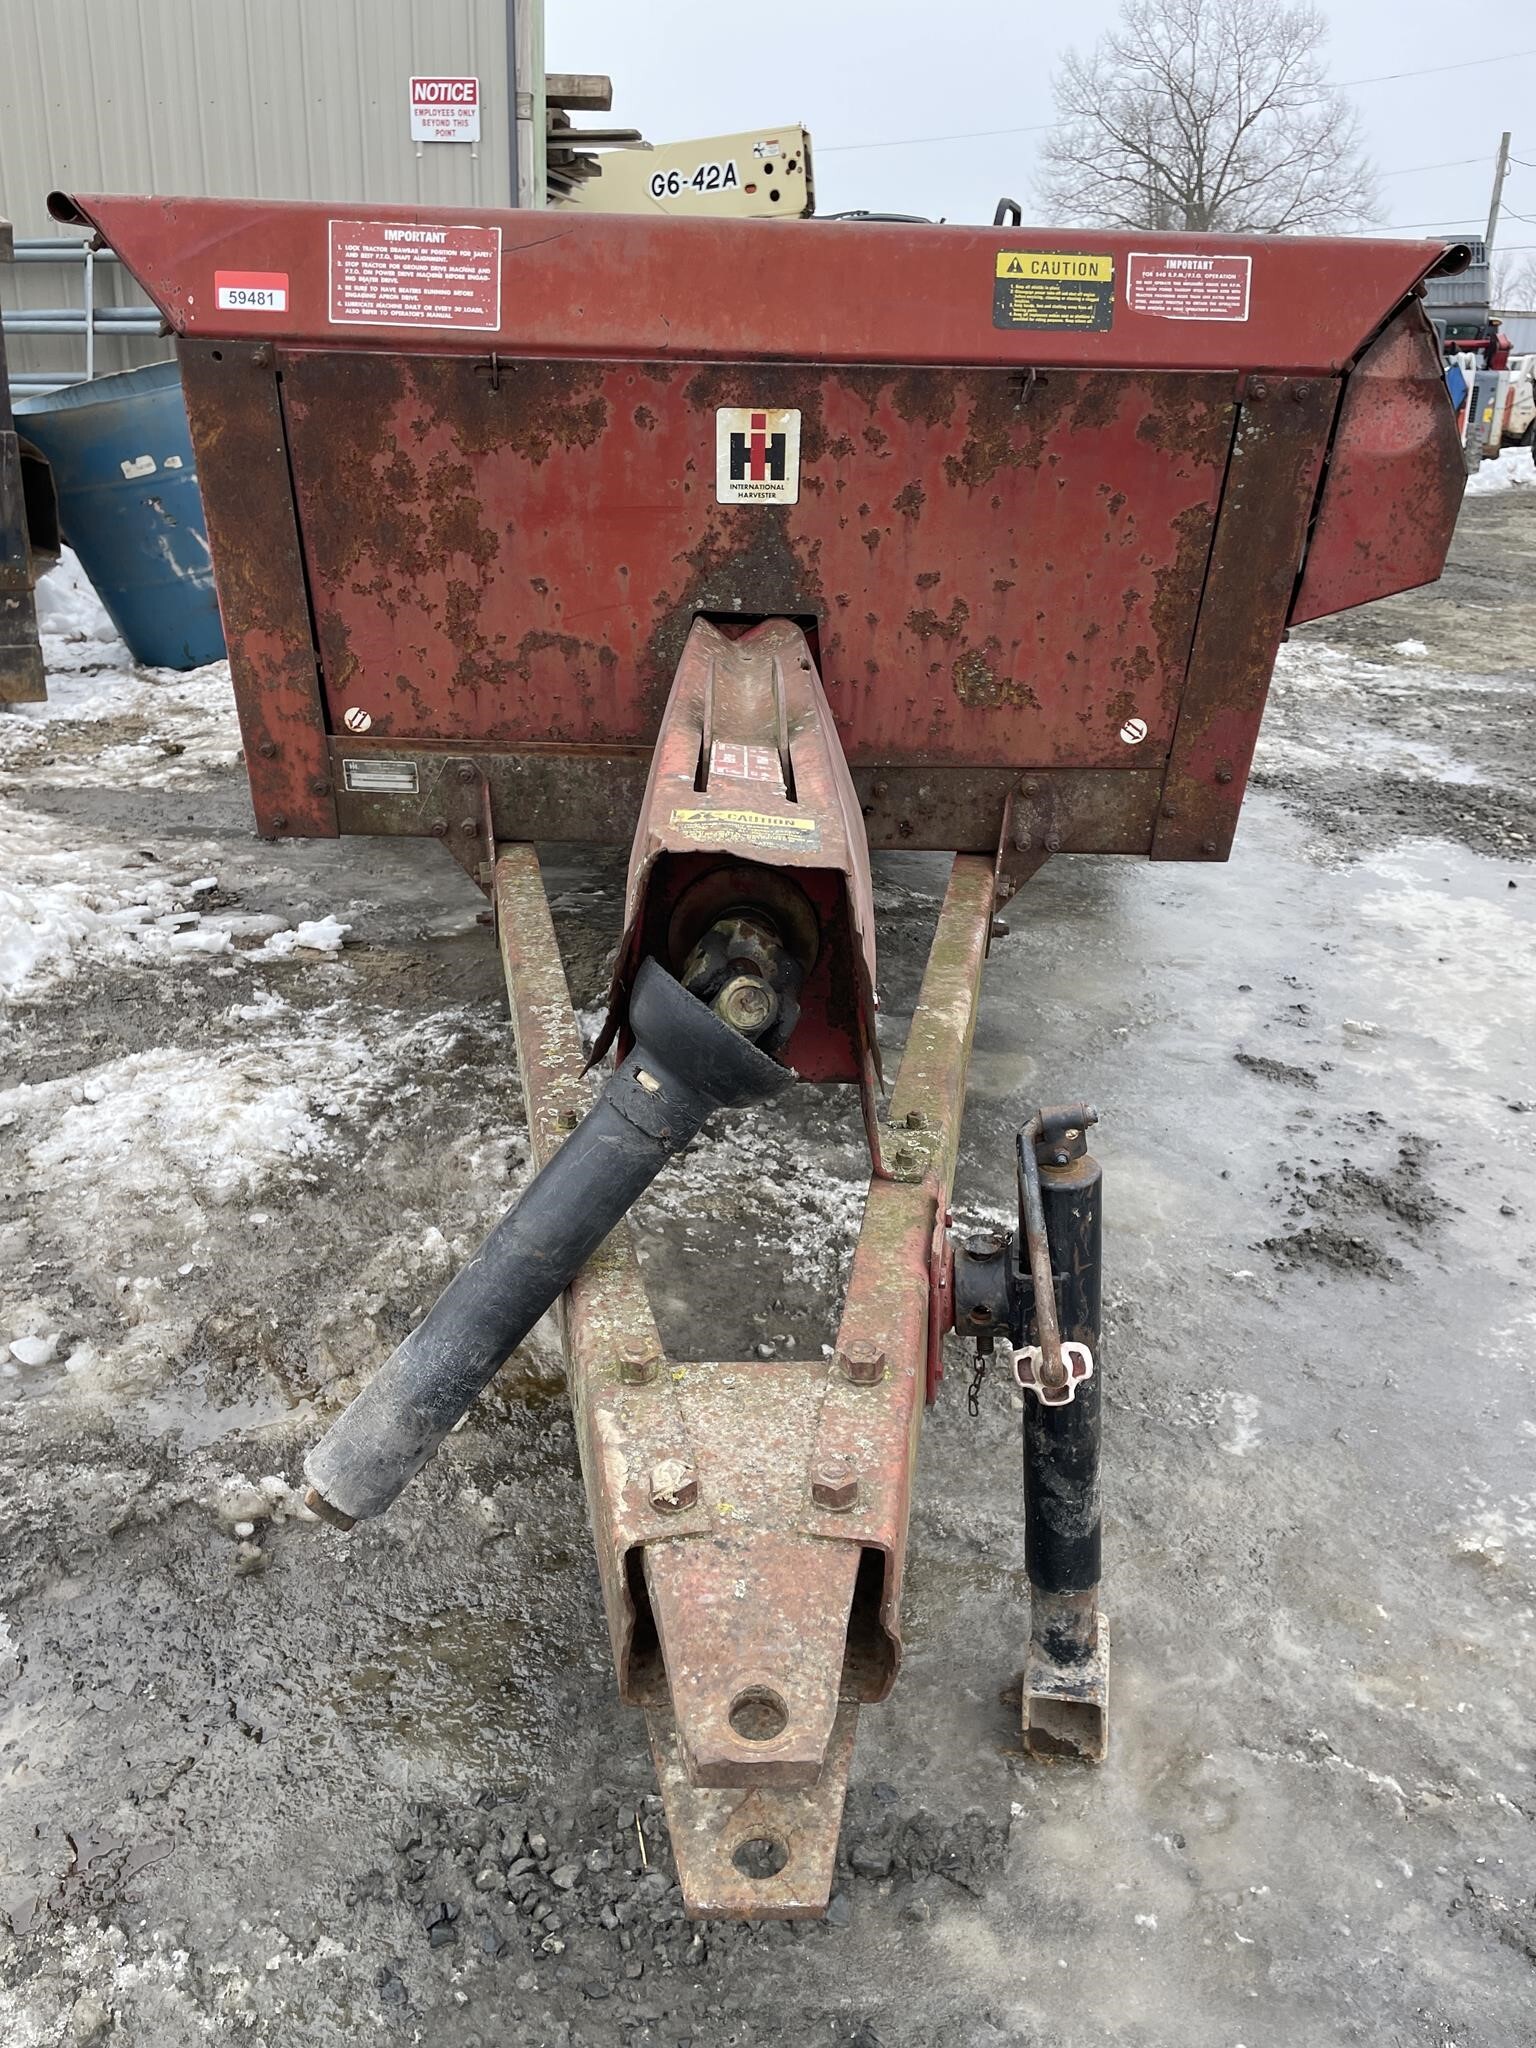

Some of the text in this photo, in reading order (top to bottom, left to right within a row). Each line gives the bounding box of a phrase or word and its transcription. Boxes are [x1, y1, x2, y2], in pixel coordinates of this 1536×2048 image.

[414, 83, 475, 101] NOTICE
[422, 119, 450, 127] BEYOND
[651, 162, 737, 197] G6-42A
[384, 230, 447, 244] IMPORTANT
[1031, 260, 1099, 276] CAUTION
[1166, 260, 1214, 270] IMPORTANT
[229, 291, 274, 306] 59481
[727, 813, 796, 826] CAUTION
